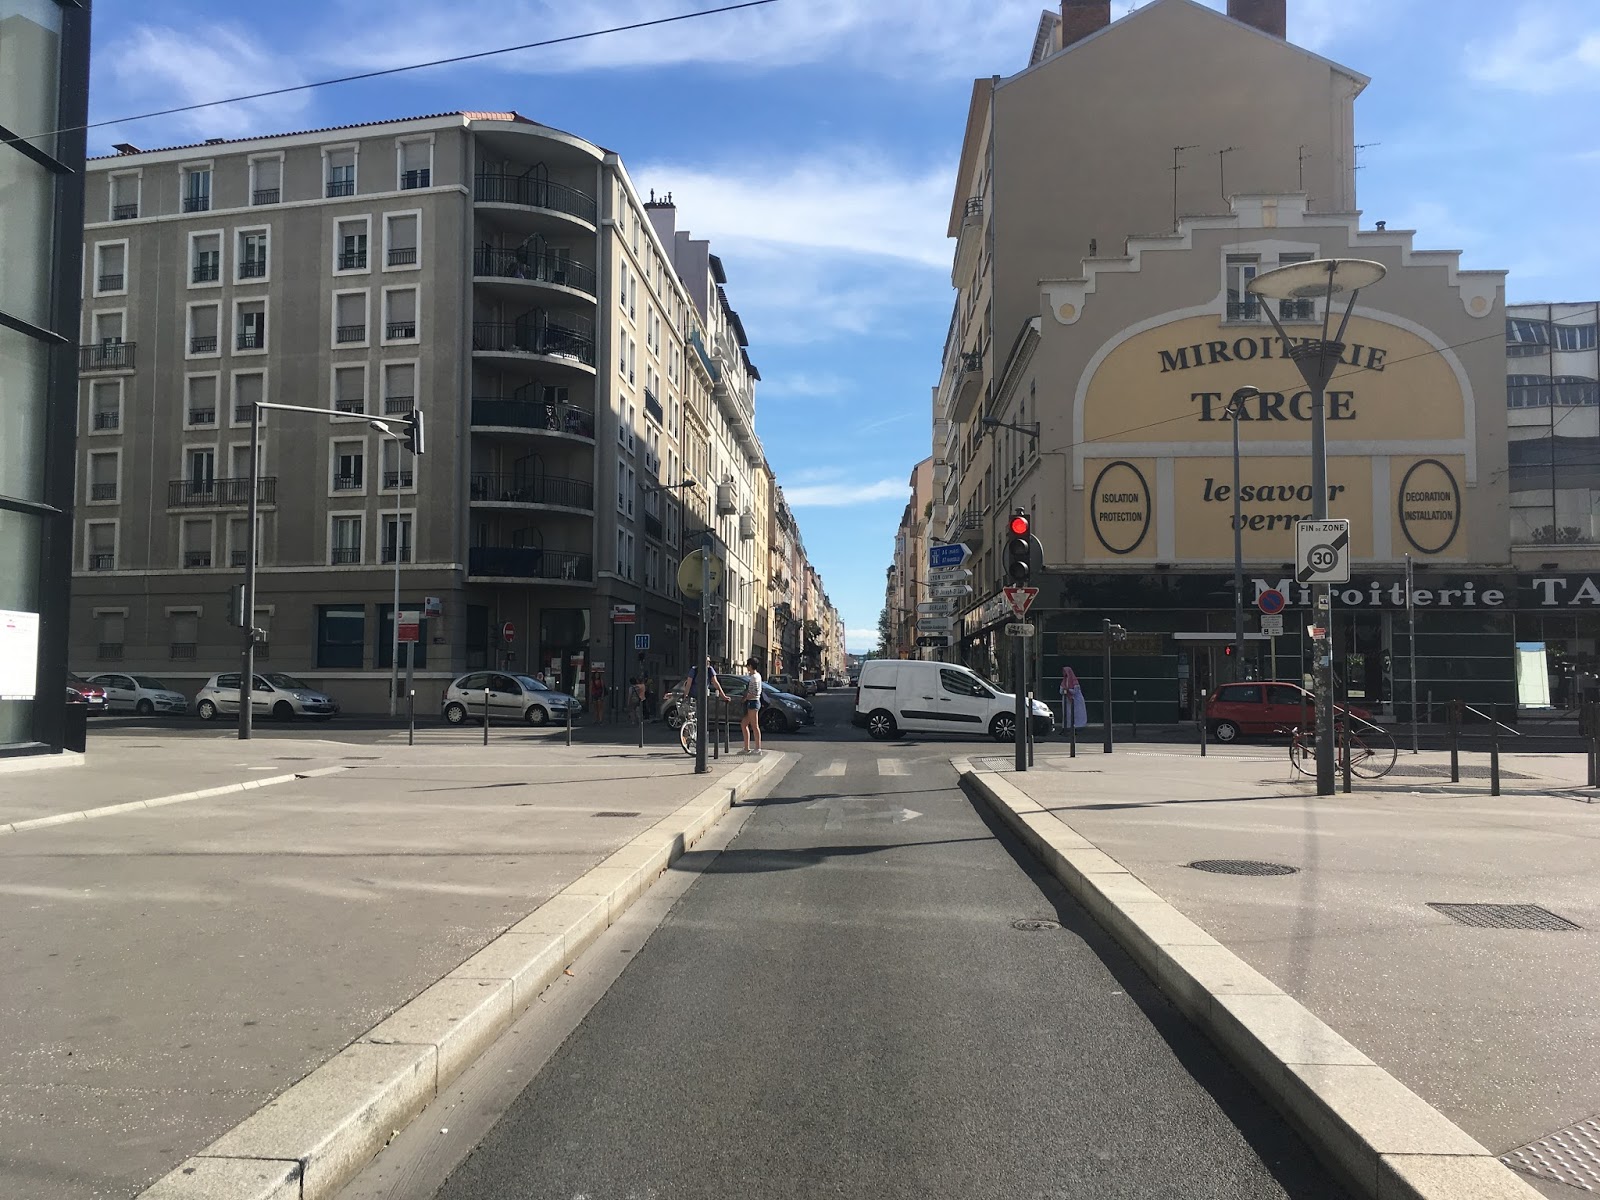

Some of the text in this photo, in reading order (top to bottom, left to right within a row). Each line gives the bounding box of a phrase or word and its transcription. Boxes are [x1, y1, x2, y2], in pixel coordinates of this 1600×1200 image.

[1158, 336, 1387, 373] MIROITIE
[1203, 478, 1345, 502] le savor
[1102, 493, 1139, 503] ISOLATION
[1405, 491, 1451, 502] DECORATION
[1099, 512, 1142, 522] PROTECTION
[1404, 510, 1453, 521] INSTALLATION
[1229, 513, 1313, 531] verr
[1322, 524, 1345, 532] ZONE
[1313, 551, 1333, 565] 30
